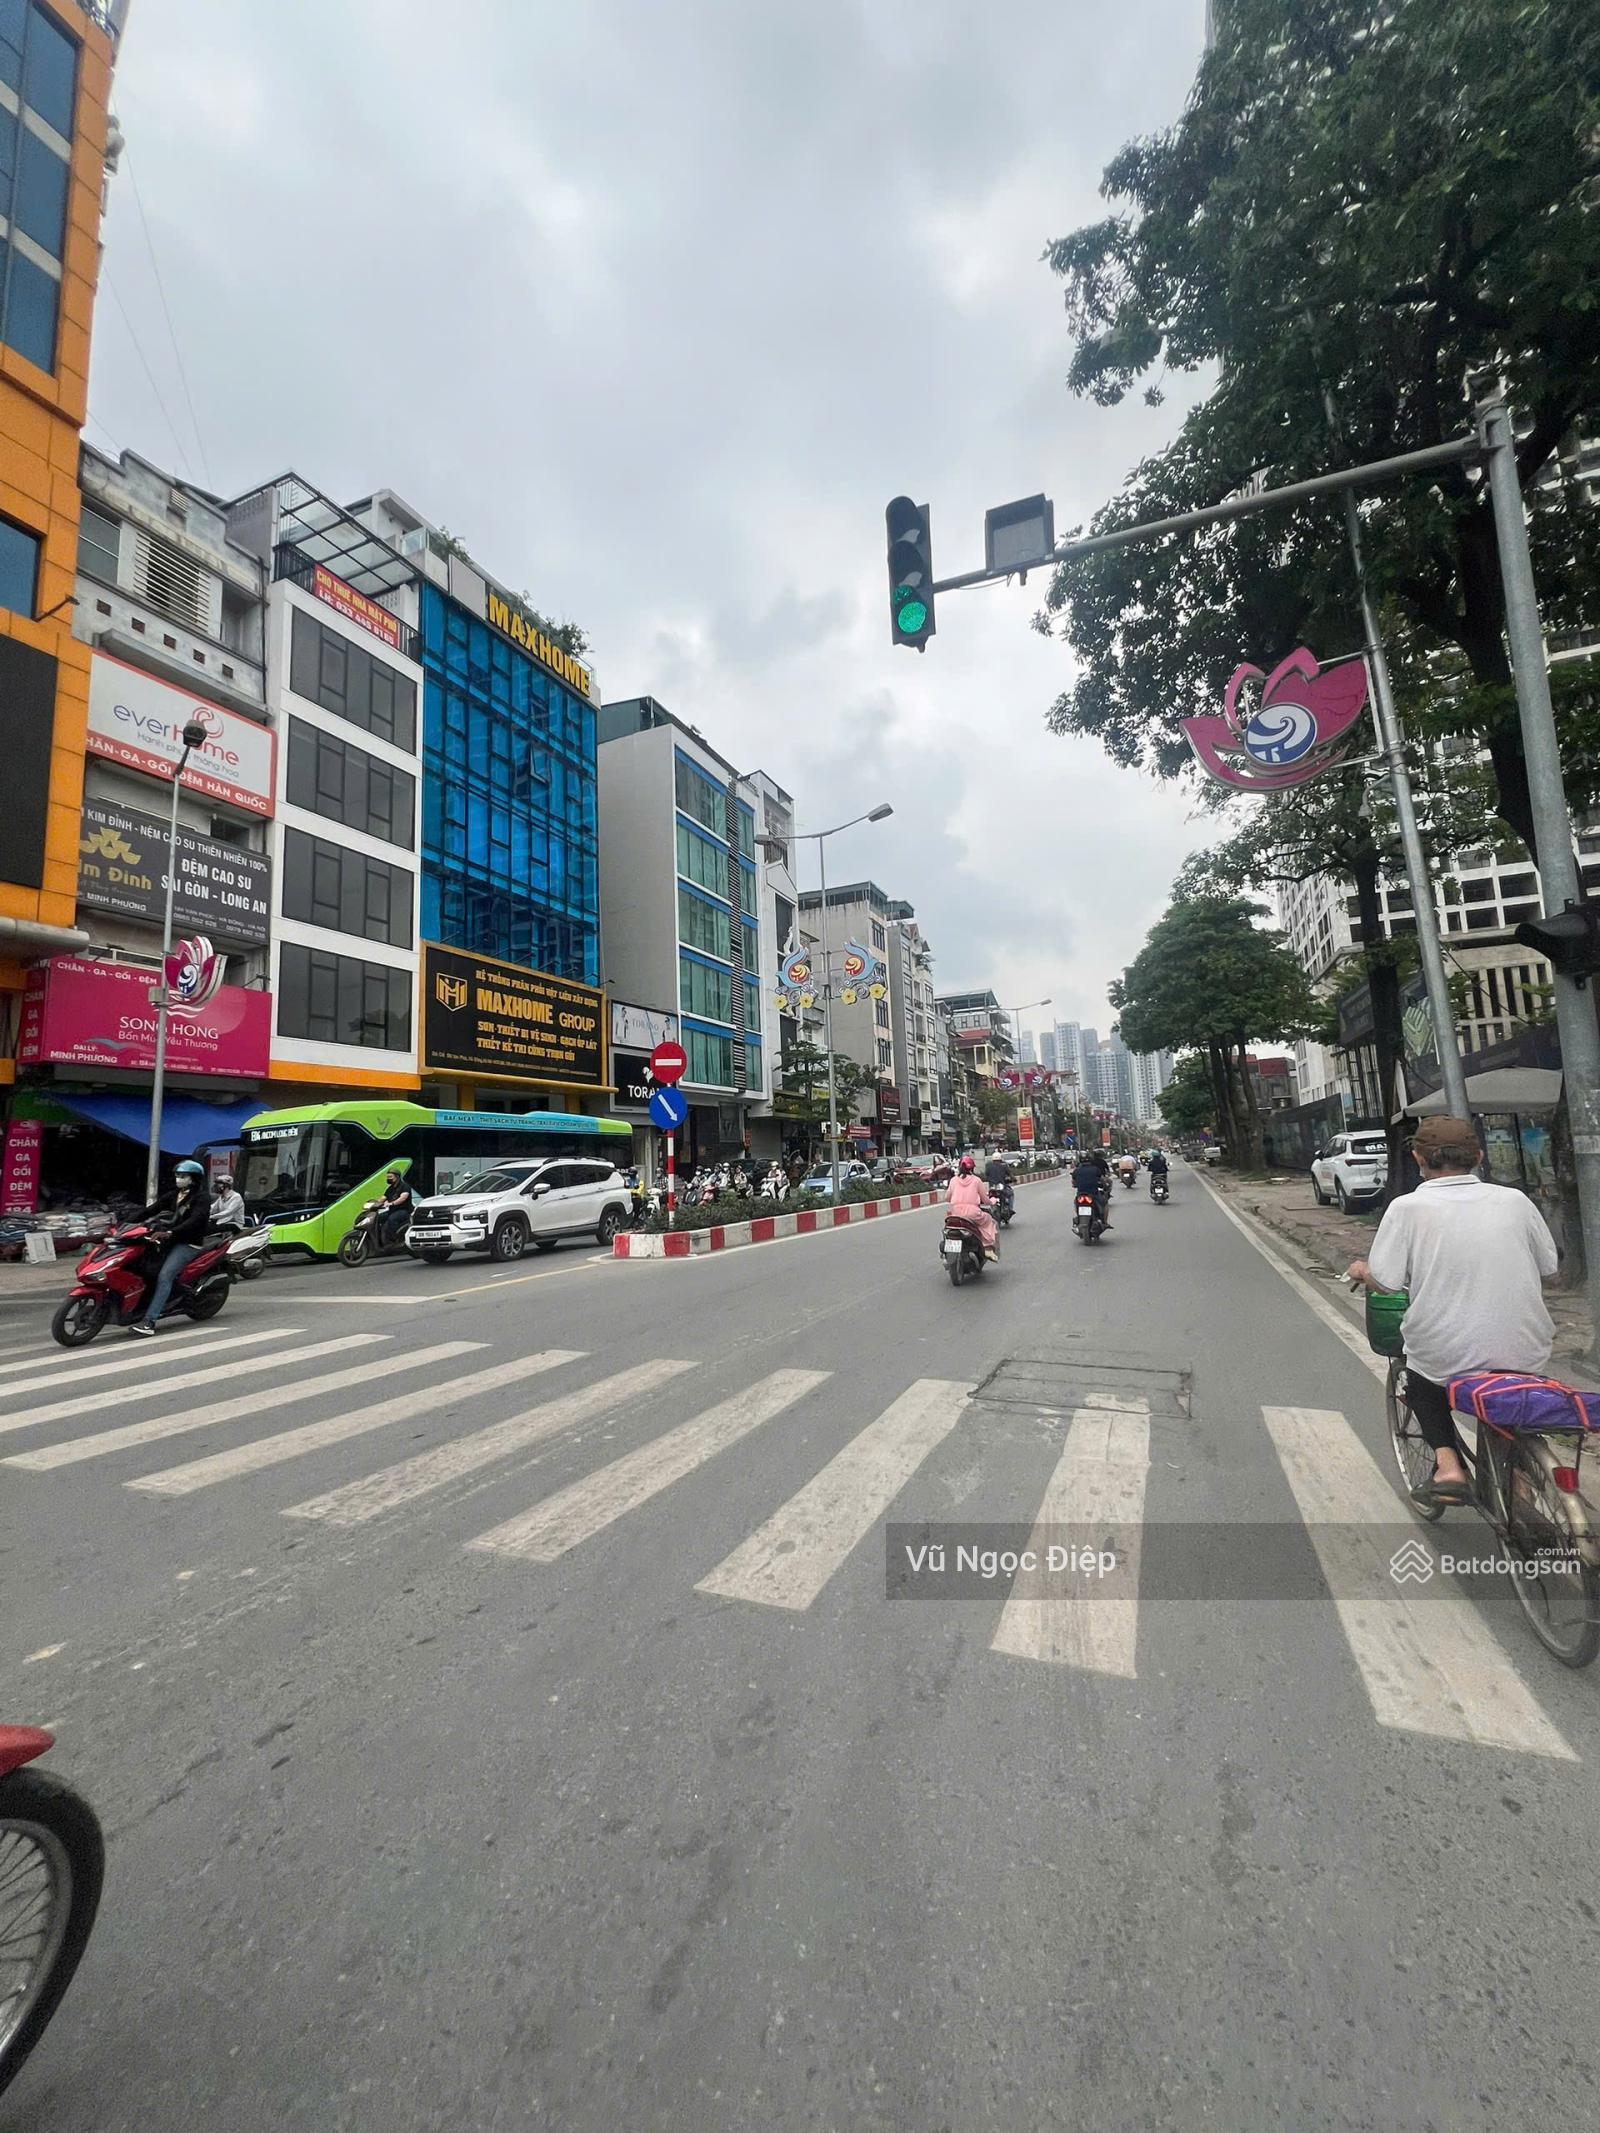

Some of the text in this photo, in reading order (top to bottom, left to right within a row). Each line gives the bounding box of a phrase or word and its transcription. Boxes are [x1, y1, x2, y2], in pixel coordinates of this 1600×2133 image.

[316, 570, 332, 589] CHO
[489, 591, 591, 698] MAXHOME
[113, 704, 240, 766] everHme
[87, 808, 106, 824] KIM
[163, 832, 182, 846] CO
[183, 838, 196, 850] SU
[249, 859, 268, 873] 100%
[79, 859, 101, 878] im
[181, 858, 252, 890] ĐỆM CAO SU
[185, 880, 209, 900] GÒN
[221, 891, 250, 911] LONG
[252, 899, 268, 915] AN
[57, 961, 85, 974] CHĂN
[93, 968, 107, 977] GA
[115, 970, 131, 981] GỐI
[476, 988, 596, 1032] MAXHOME GROUP
[172, 1023, 219, 1040] HONG
[50, 1051, 76, 1060] MINH
[513, 1043, 527, 1054] THI
[627, 1084, 659, 1100] TORA
[9, 1136, 39, 1147] CHĂN
[15, 1153, 31, 1162] GA
[12, 1164, 32, 1177] GỐI
